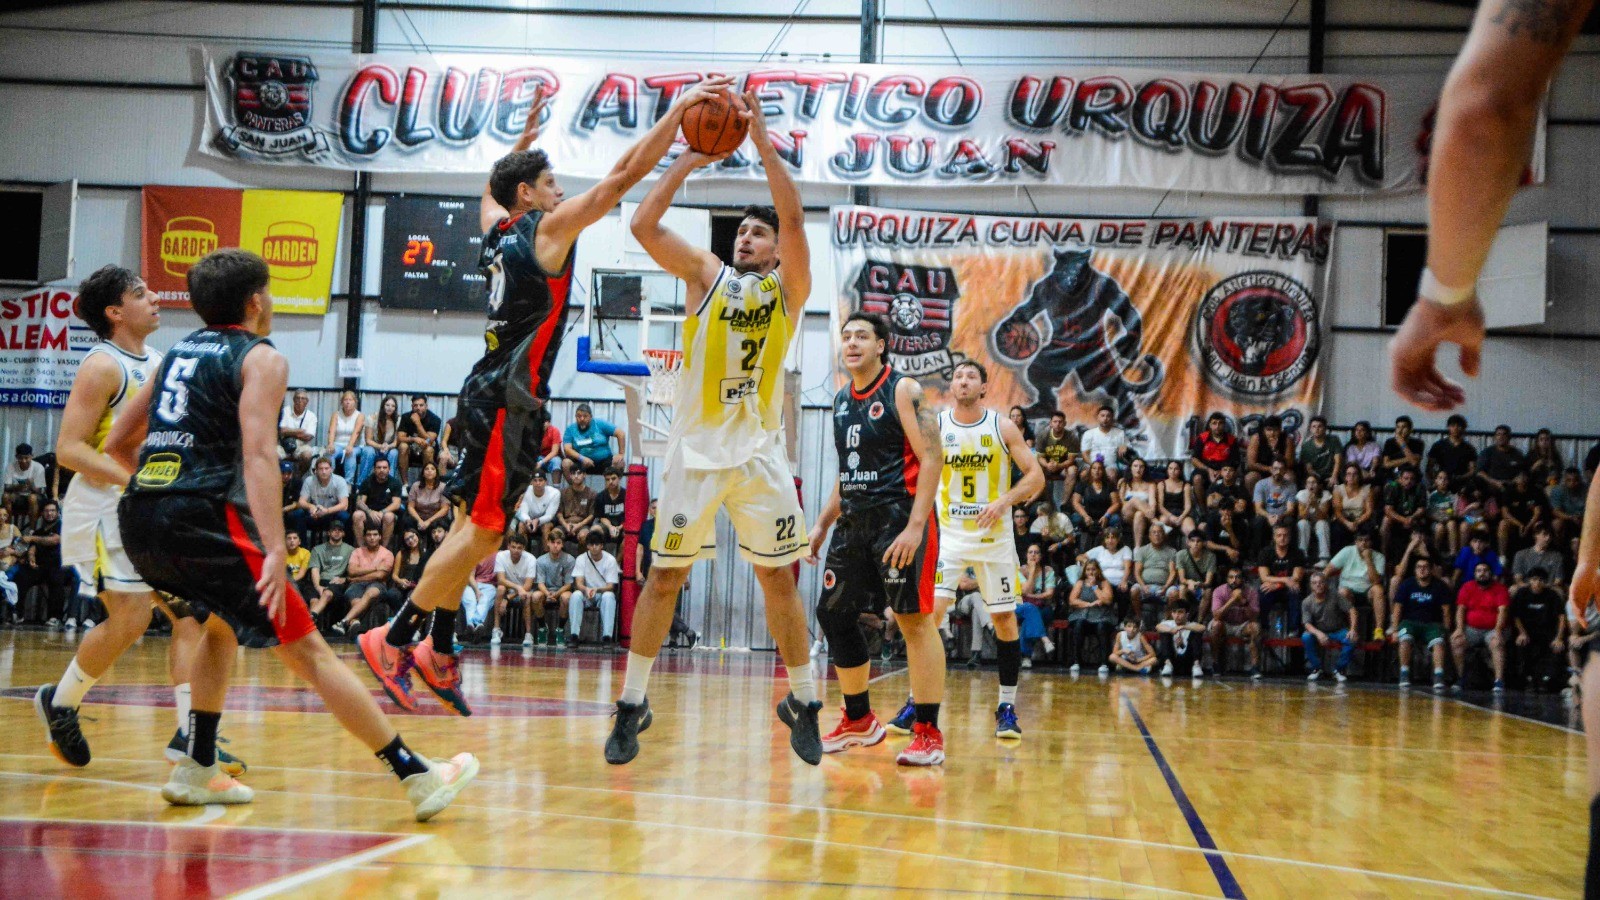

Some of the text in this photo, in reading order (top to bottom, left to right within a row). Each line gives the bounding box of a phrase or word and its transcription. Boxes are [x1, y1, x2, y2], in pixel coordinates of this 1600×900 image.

[244, 111, 305, 132] PANTERAS
[340, 65, 1386, 181] CLUB ATETICO URQUIZA
[239, 130, 308, 149] SAN JUAN
[833, 132, 1056, 175] JUAN
[835, 210, 1332, 260] URQUIZA CUNA DE PANTERAS
[164, 236, 216, 256] GARDEN
[264, 240, 317, 262] GARDEN
[402, 240, 435, 265] 27
[404, 271, 429, 279] FALTAS
[889, 333, 943, 353] NTERAS
[58, 358, 80, 366] VASOS
[902, 354, 946, 372] JUAN
[11, 394, 19, 403] a
[156, 356, 200, 423] 5
[147, 430, 195, 448] URQUIZA
[846, 423, 862, 449] 15
[945, 451, 994, 465] UNIÓN
[141, 465, 179, 477] GARDEN
[851, 469, 878, 482] Juan
[842, 483, 868, 491] Gobierno
[963, 475, 975, 498] 5
[775, 514, 796, 541] 22
[1000, 576, 1010, 594] 5
